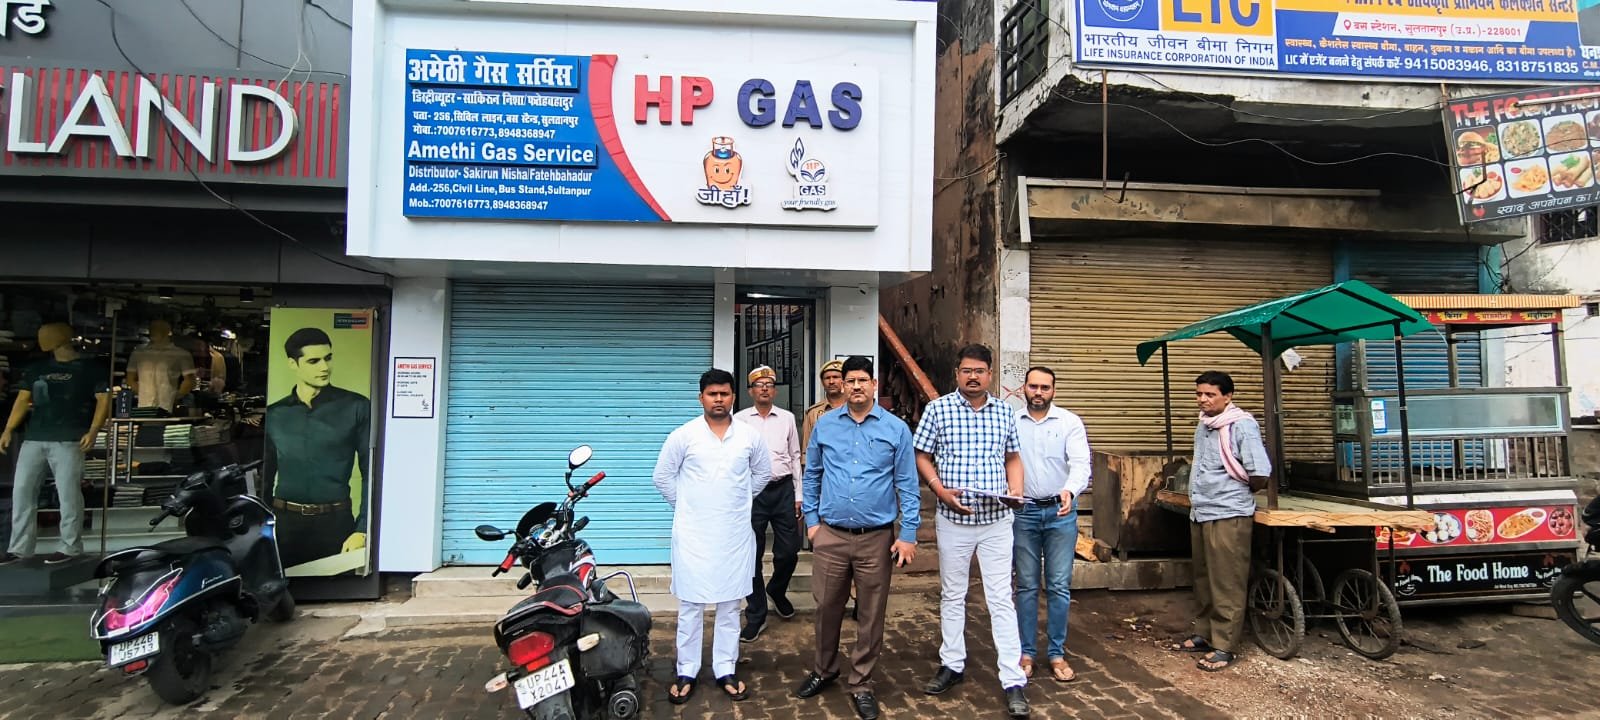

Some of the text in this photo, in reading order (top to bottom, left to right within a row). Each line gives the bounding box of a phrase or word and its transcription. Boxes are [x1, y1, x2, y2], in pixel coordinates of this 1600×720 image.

[1353, 21, 1368, 30] बस
[1085, 32, 1274, 54] भारतीय जीवन बीमा निगम
[1084, 48, 1275, 66] LIFE INSURANCE CORPORATION OF INDIA
[1285, 54, 1299, 65] LIC
[1496, 60, 1579, 74] 8318751835
[408, 53, 573, 87] अमेठी गैस सर्विस
[634, 74, 863, 132] HP GAS
[1450, 101, 1491, 127] THE
[408, 141, 594, 163] Amethi Gas Service
[463, 166, 499, 180] Sakirun
[805, 162, 820, 170] HP
[800, 185, 826, 195] GAS
[1427, 564, 1452, 583] The
[1456, 563, 1489, 582] Food
[1492, 561, 1529, 580] Home
